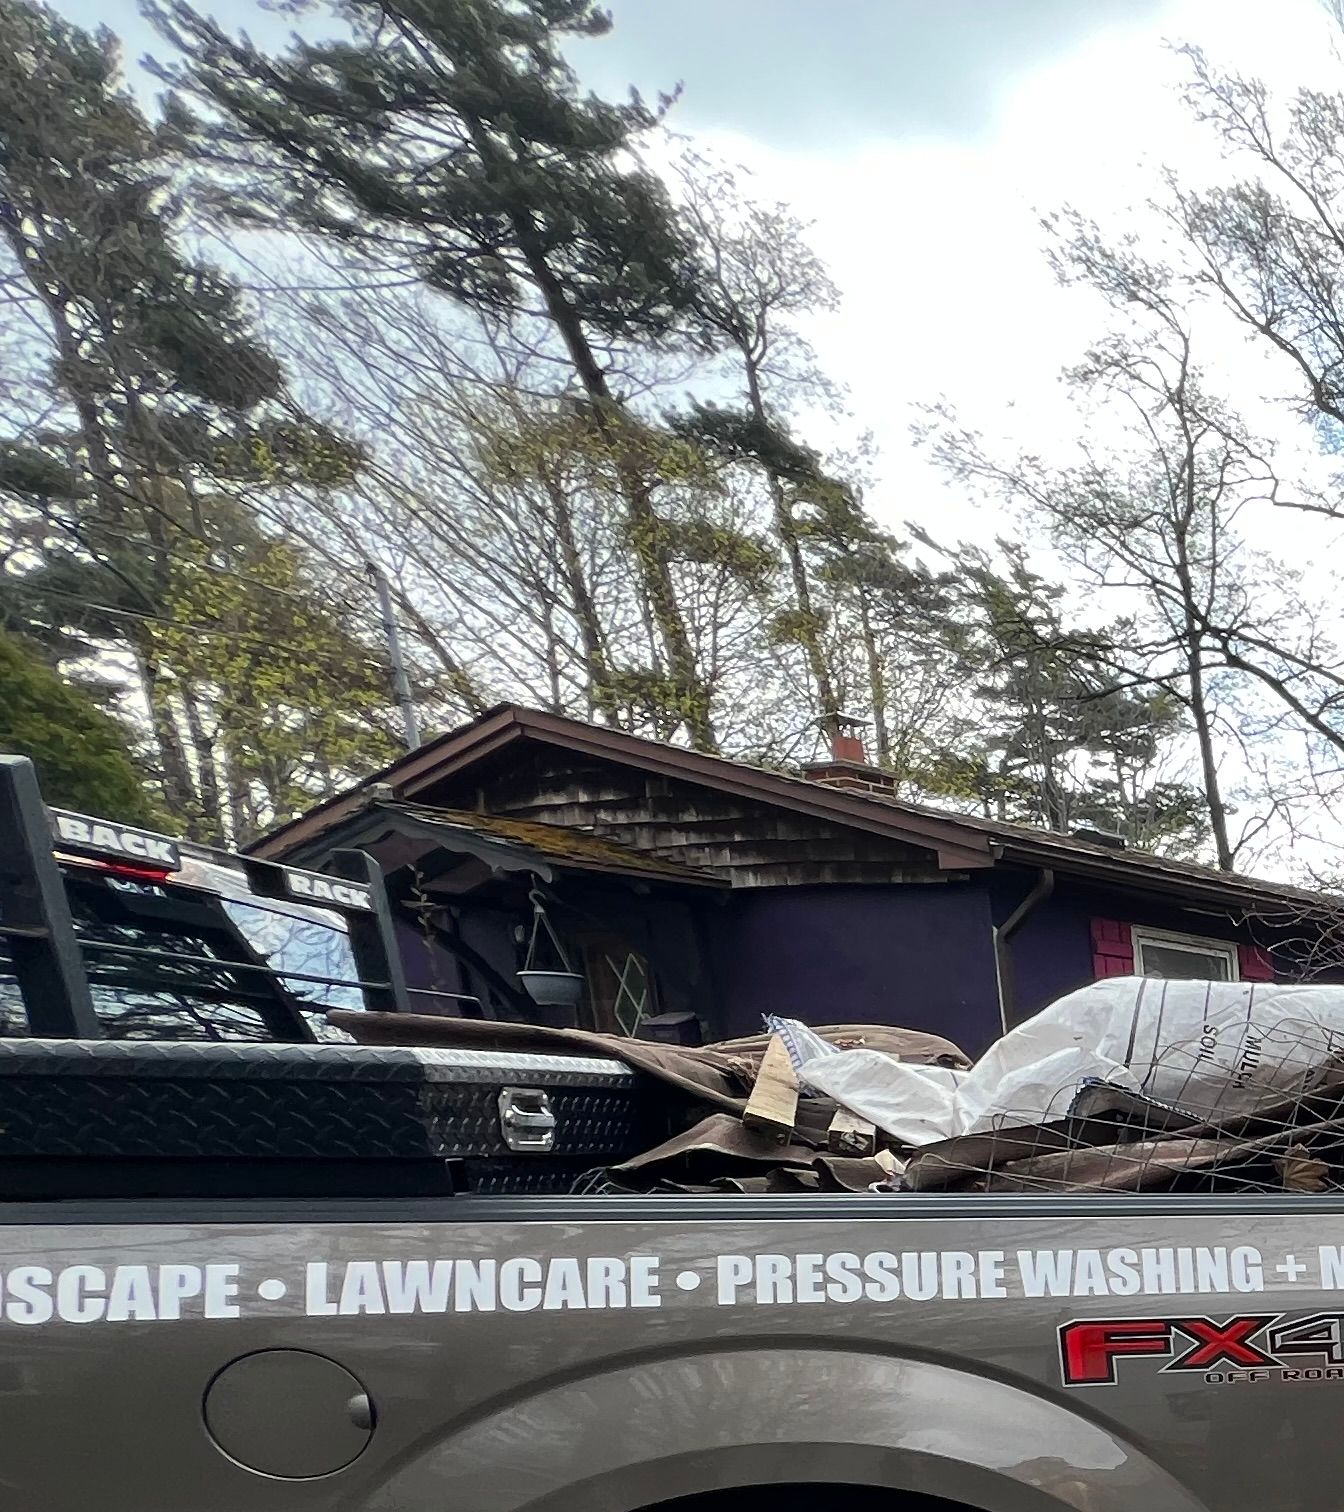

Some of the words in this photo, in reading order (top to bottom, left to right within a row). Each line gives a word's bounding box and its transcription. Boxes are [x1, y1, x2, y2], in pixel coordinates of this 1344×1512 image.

[56, 816, 175, 864] BACK
[288, 873, 373, 909] RACK
[1199, 1024, 1218, 1062] SOIL
[1232, 1035, 1262, 1090] MULCH
[0, 1263, 240, 1325] SCAPE
[305, 1256, 662, 1316] LAWNCARE
[717, 1250, 1008, 1305] PRESSURE
[1016, 1246, 1266, 1298] WASHING
[1275, 1255, 1307, 1282] +
[1204, 1369, 1269, 1385] OFF
